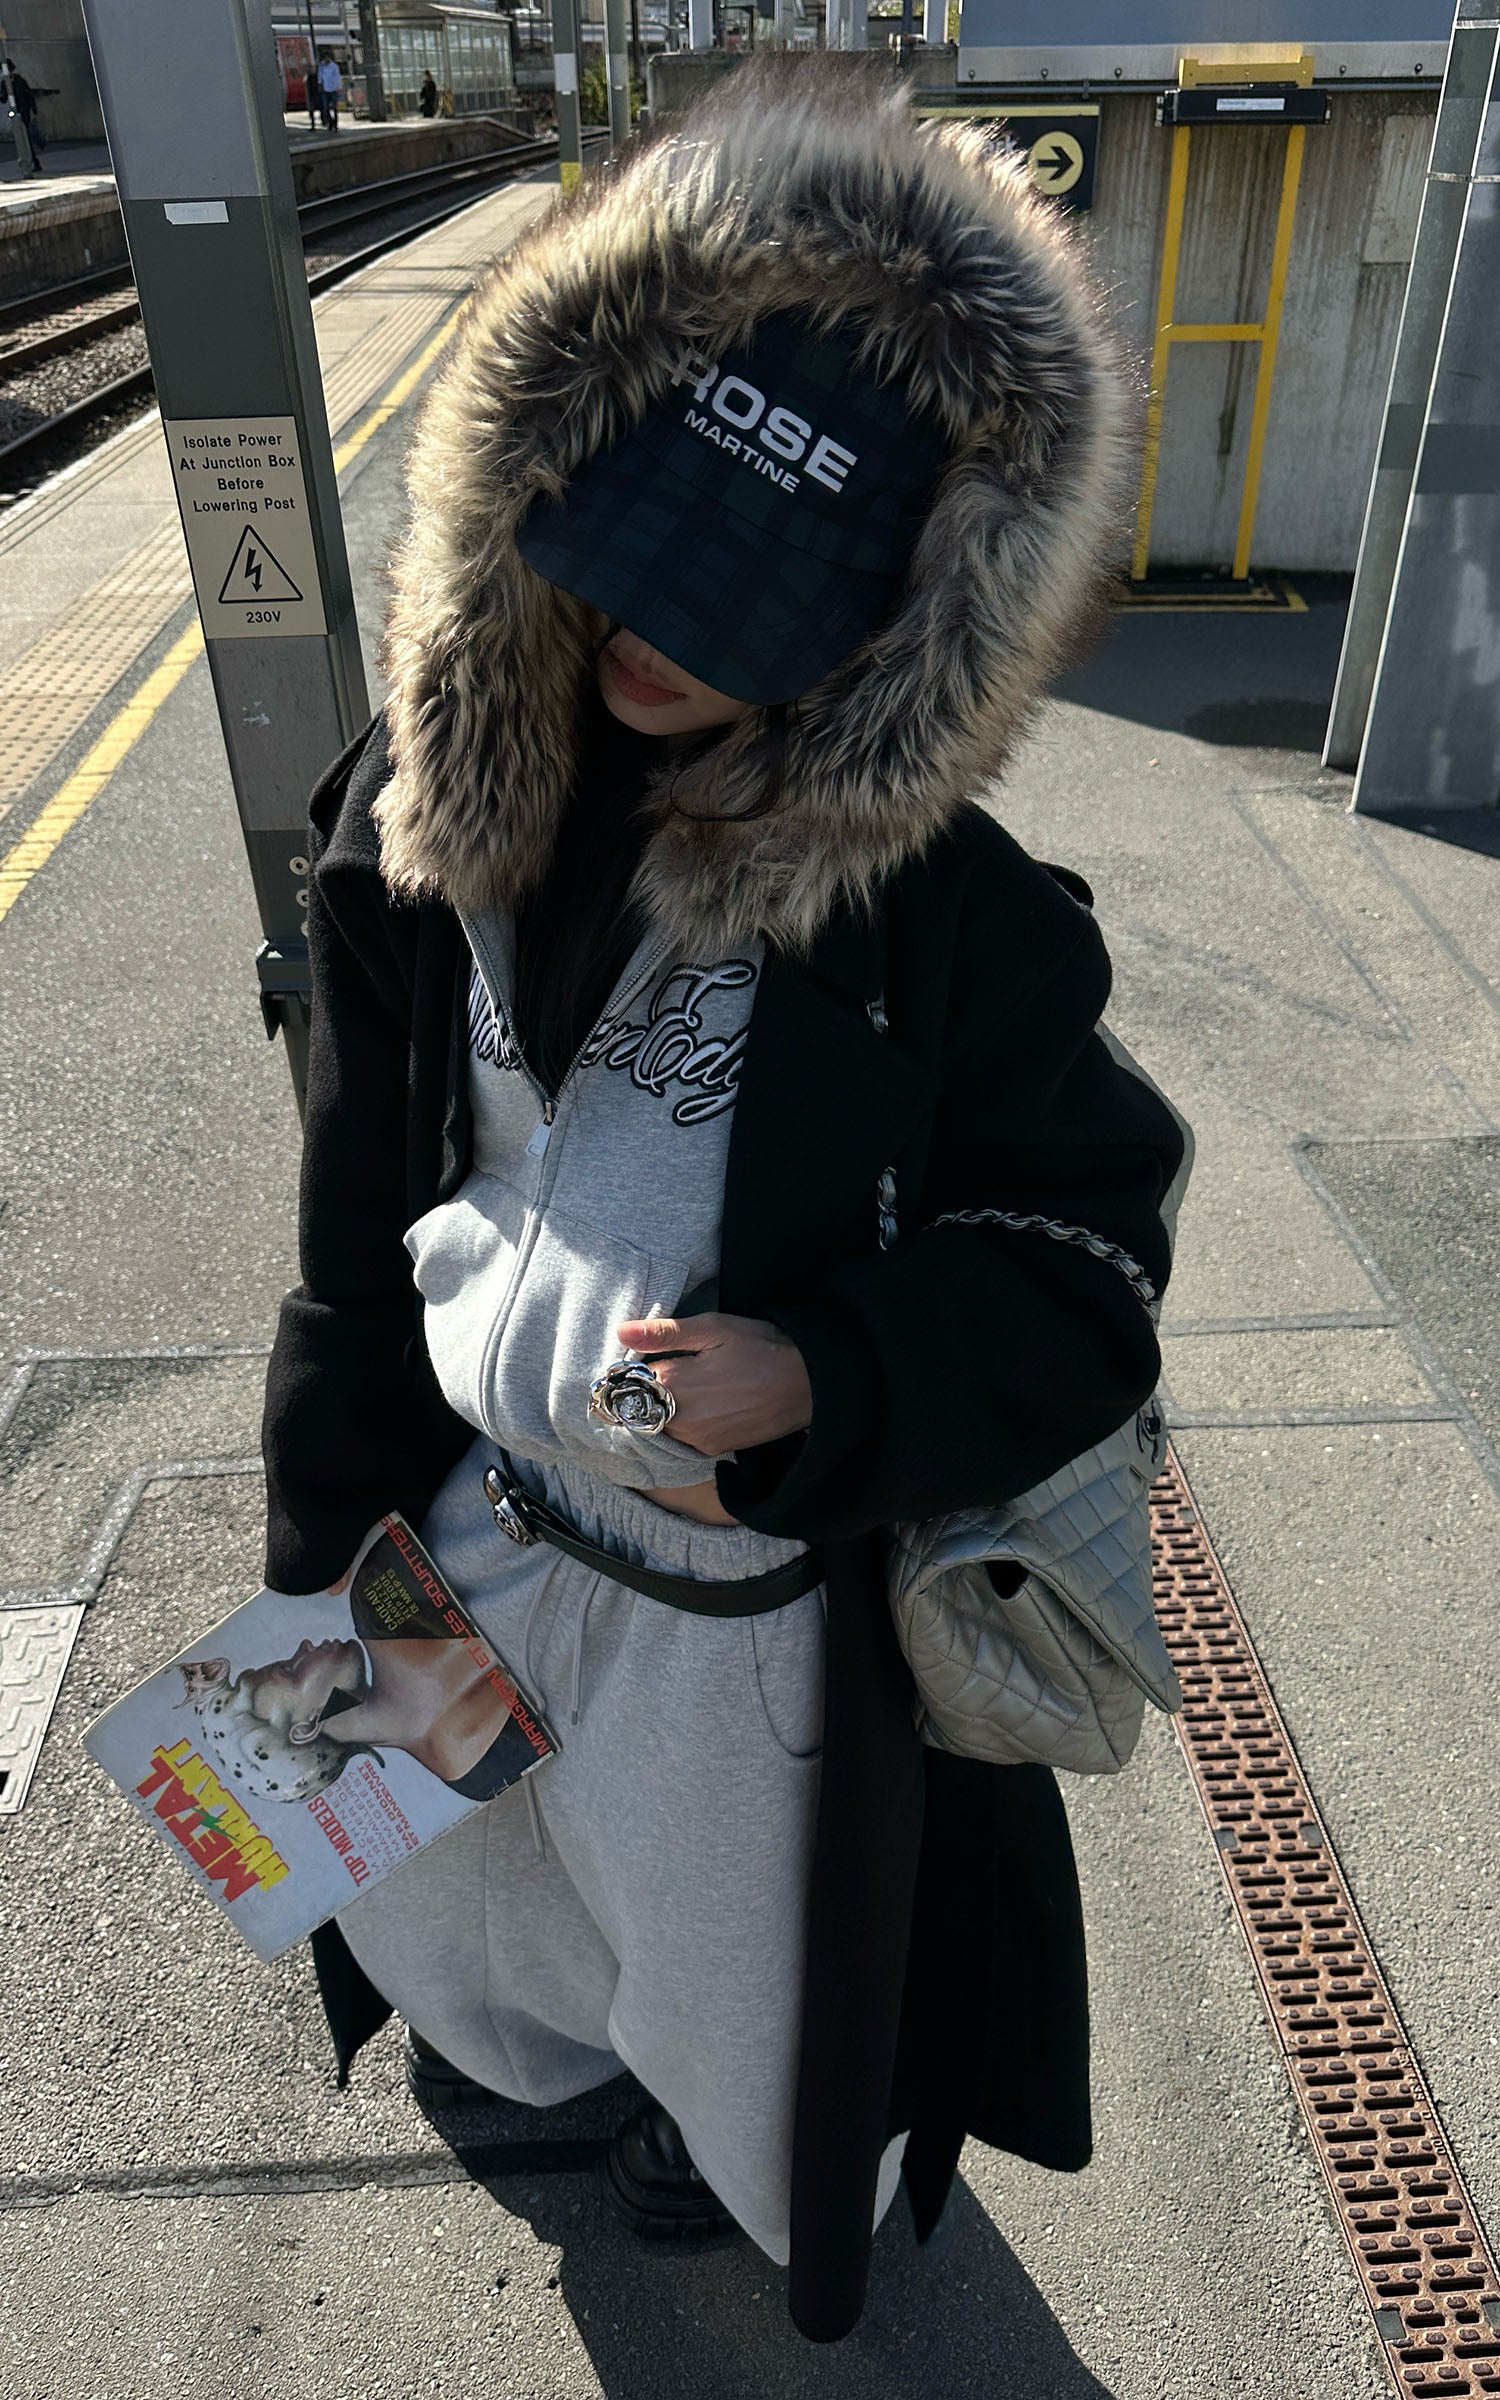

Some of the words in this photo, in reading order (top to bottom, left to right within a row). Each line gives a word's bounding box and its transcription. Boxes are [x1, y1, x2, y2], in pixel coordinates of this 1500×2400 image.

[670, 348, 858, 493] ROSE
[183, 434, 232, 449] Isolate
[238, 433, 283, 447] Power
[684, 409, 800, 493] MARTINE
[179, 457, 197, 471] At
[202, 455, 262, 470] Junction
[268, 454, 296, 468] Box
[216, 477, 265, 491] Before
[193, 498, 258, 514] Lowering
[264, 497, 296, 511] Post
[246, 610, 281, 624] 230V
[380, 1515, 448, 1609] SQUATTERS
[443, 1608, 475, 1645] LES
[468, 1645, 490, 1669] ET
[486, 1668, 551, 1756] MARGERIN
[356, 1765, 397, 1821] DIONNET
[135, 1755, 261, 1903] METAL
[152, 1736, 291, 1892] HURLANT
[308, 1794, 355, 1858] MODELS
[394, 1822, 414, 1851] PAR
[407, 1830, 420, 1847] ET
[343, 1855, 371, 1888] TOP
